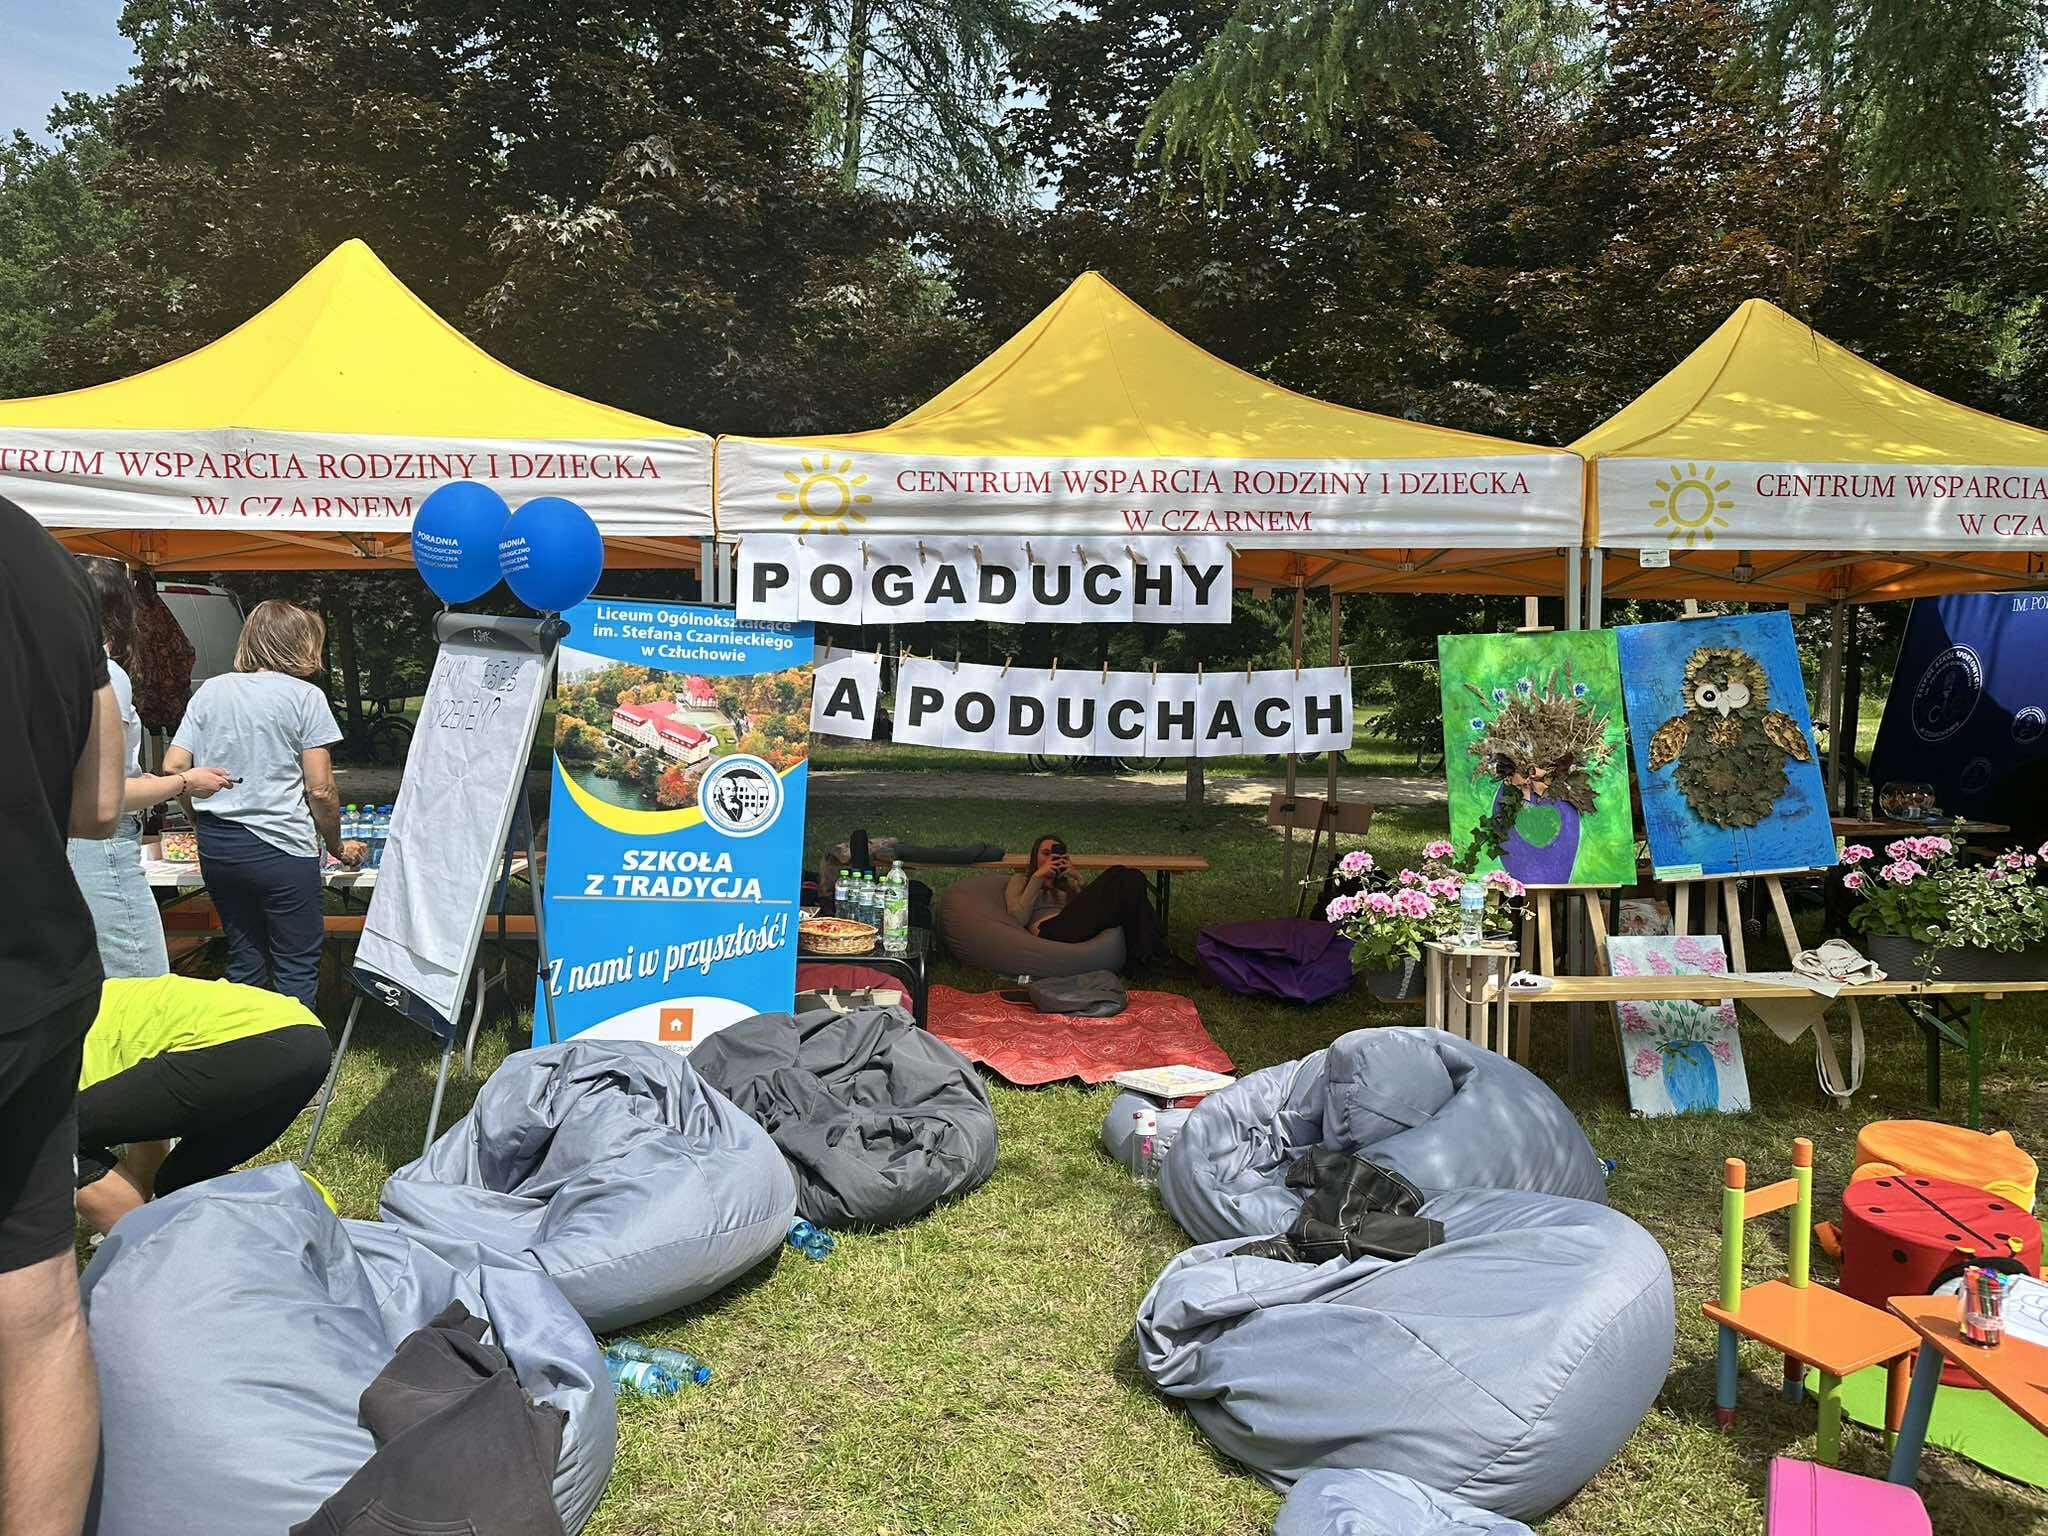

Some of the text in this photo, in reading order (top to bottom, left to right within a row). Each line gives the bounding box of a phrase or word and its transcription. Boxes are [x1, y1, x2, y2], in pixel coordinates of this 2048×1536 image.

[0, 448, 662, 479] TRUM WSPARCIA RODZINY I DZIECKA
[896, 469, 1531, 495] CENTRUM WSPARCIA RODZINY I DZIECKA
[1756, 473, 2048, 500] CENTRUM WSPARCIA
[192, 496, 413, 518] W CZARNEM
[1120, 509, 1313, 533] W CZARNEM
[1957, 514, 2048, 537] W CZA
[417, 530, 459, 547] PORADNIA
[752, 561, 1223, 606] POGADUCHY
[2031, 596, 2048, 610] PO
[597, 607, 792, 634] Liceum Ogólnokształcące
[593, 624, 794, 651] im. Stefana Czarnieckiego
[641, 645, 747, 662] w Człuchowie
[822, 676, 1343, 741] A PODUCHACH
[623, 850, 733, 873] SZKOŁA
[584, 874, 762, 904] Z TRADYCJĄ
[568, 945, 634, 993] nami
[638, 947, 660, 979] w
[663, 912, 789, 984] przyszłość!
